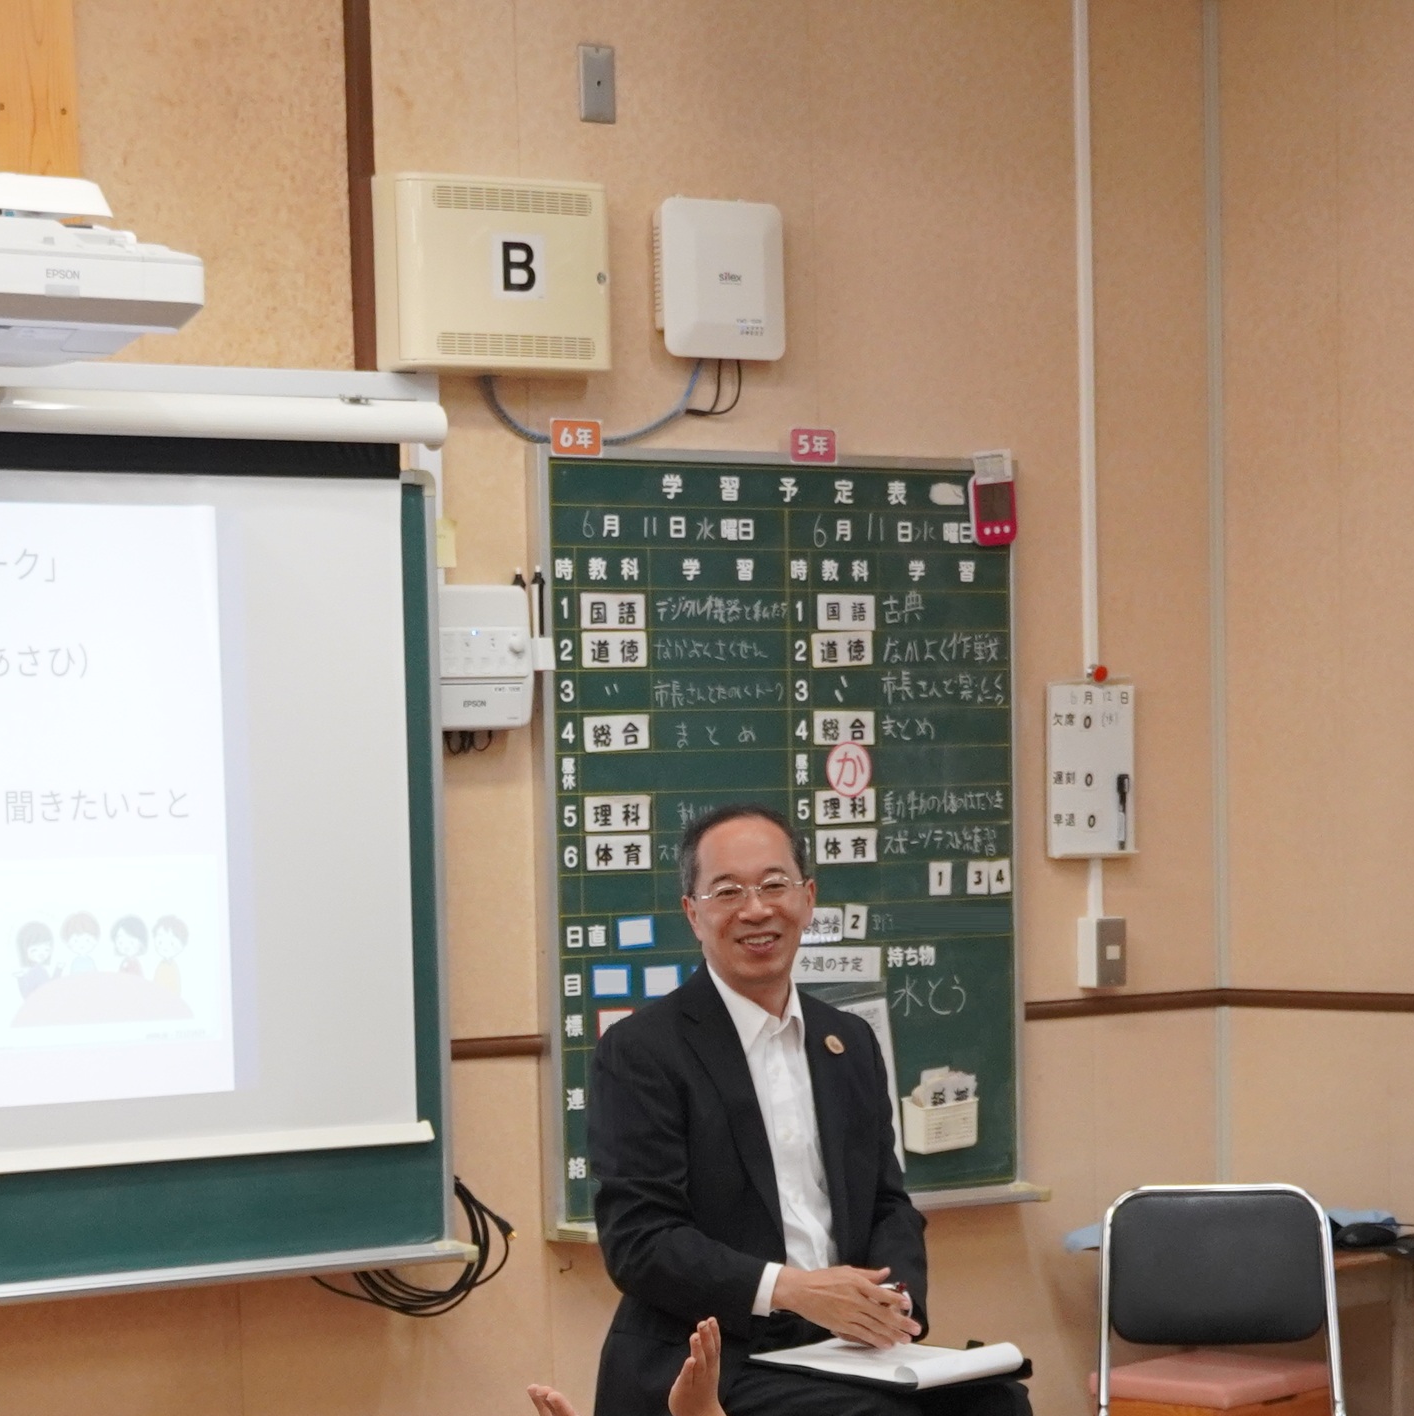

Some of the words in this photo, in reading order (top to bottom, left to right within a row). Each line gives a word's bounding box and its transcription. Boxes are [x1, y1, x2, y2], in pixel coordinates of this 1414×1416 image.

[45, 268, 81, 280] EPSON
[502, 241, 536, 292] B
[718, 272, 742, 282] silex
[560, 427, 594, 448] 6年
[797, 434, 829, 455] 5年
[662, 473, 907, 505] 学習予定表
[555, 558, 573, 580] 時
[588, 557, 640, 581] 教科
[682, 558, 754, 581] 学習
[790, 559, 808, 581] 時
[821, 558, 869, 582] 教科
[908, 560, 975, 582] 学習
[560, 597, 569, 619] 1
[590, 601, 637, 625] 国語
[795, 601, 803, 622] 1
[826, 602, 866, 621] 国語
[882, 591, 925, 623] 古典
[559, 639, 573, 661] 2
[591, 640, 639, 663] 道徳
[795, 640, 807, 662] 2
[820, 639, 866, 663] 道徳
[560, 680, 574, 702] 3
[795, 680, 809, 701] 3
[463, 700, 487, 708] EPSON
[795, 719, 808, 741] 4
[822, 718, 866, 741] 総合
[881, 715, 936, 741] まとめ
[1053, 713, 1076, 726] 欠席
[561, 722, 575, 744] 4
[593, 722, 639, 748] 総合
[675, 722, 756, 749] まとめ
[836, 752, 865, 787] か
[1053, 771, 1076, 785] 遅刻
[563, 806, 577, 827] 5
[593, 803, 640, 827] 理科
[797, 799, 810, 820] 5
[823, 796, 866, 820] 理科
[1053, 813, 1076, 827] 早退
[563, 846, 578, 868] 6
[596, 843, 642, 867] 体育
[824, 837, 868, 861] 体育
[937, 871, 943, 886] 1
[974, 871, 982, 885] 3
[996, 869, 1005, 883] 4
[850, 914, 861, 930] 2
[566, 925, 607, 948] 日直
[799, 956, 863, 973] 今週の予定
[887, 946, 936, 968] 持ち物
[891, 974, 967, 1017] 水とう
